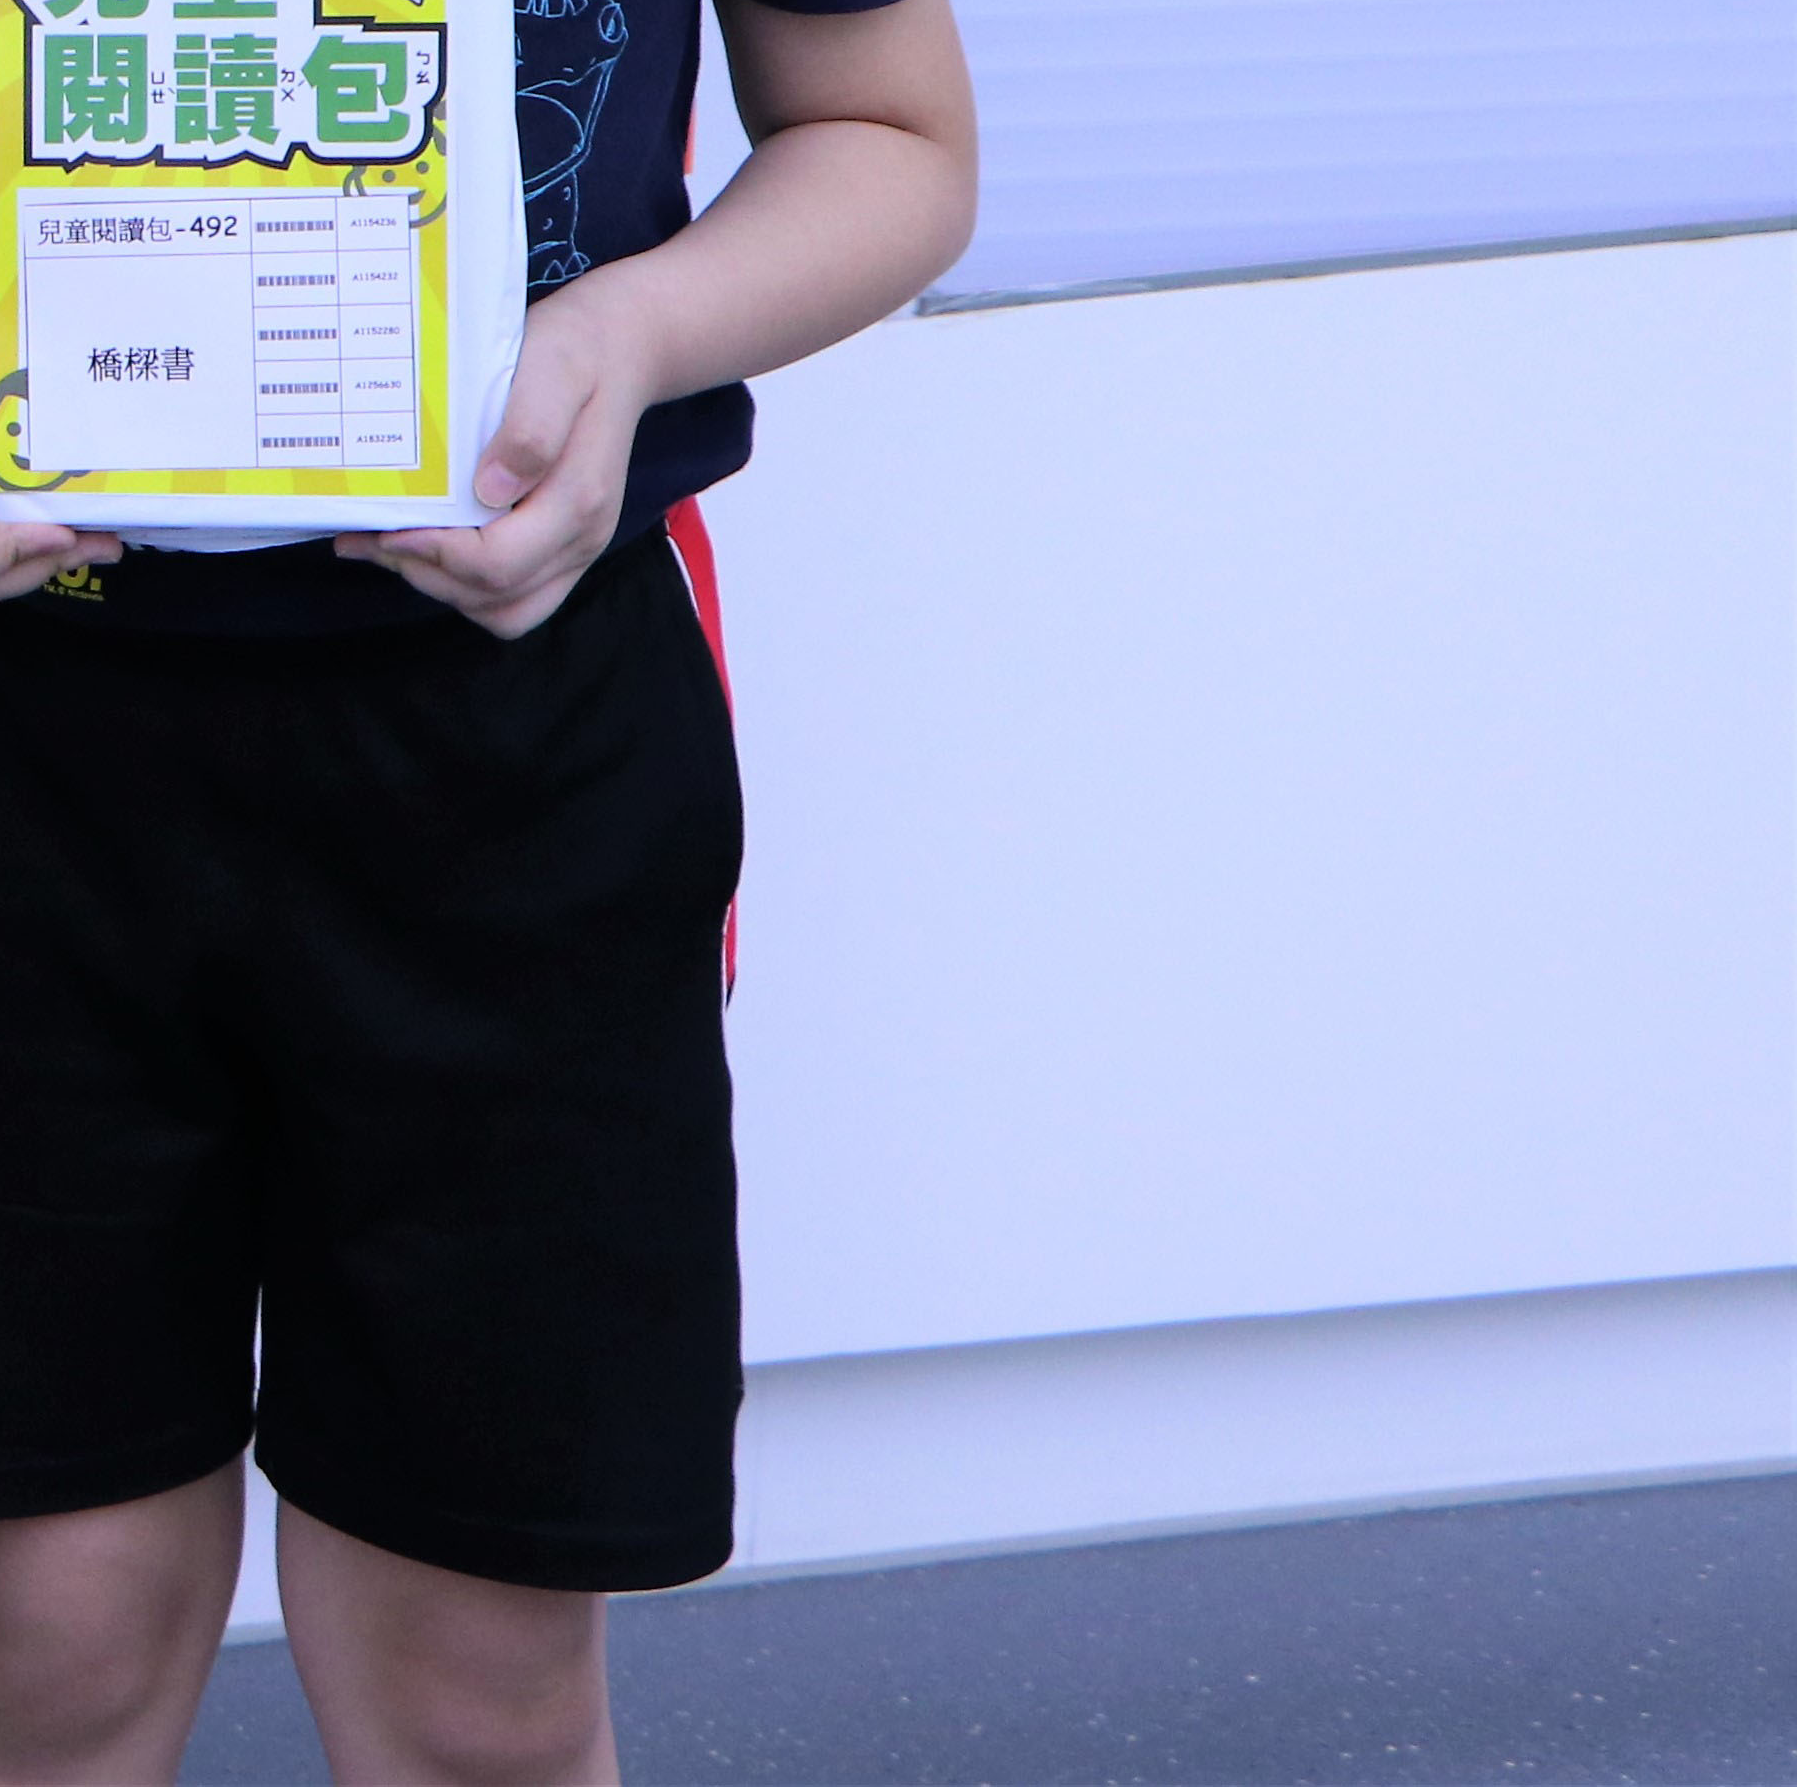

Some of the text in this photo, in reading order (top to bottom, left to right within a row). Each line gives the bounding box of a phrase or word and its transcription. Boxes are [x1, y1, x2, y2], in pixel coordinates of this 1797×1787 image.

[43, 34, 410, 146] 閱讀包
[37, 214, 239, 246] 兒童閱讀包-492
